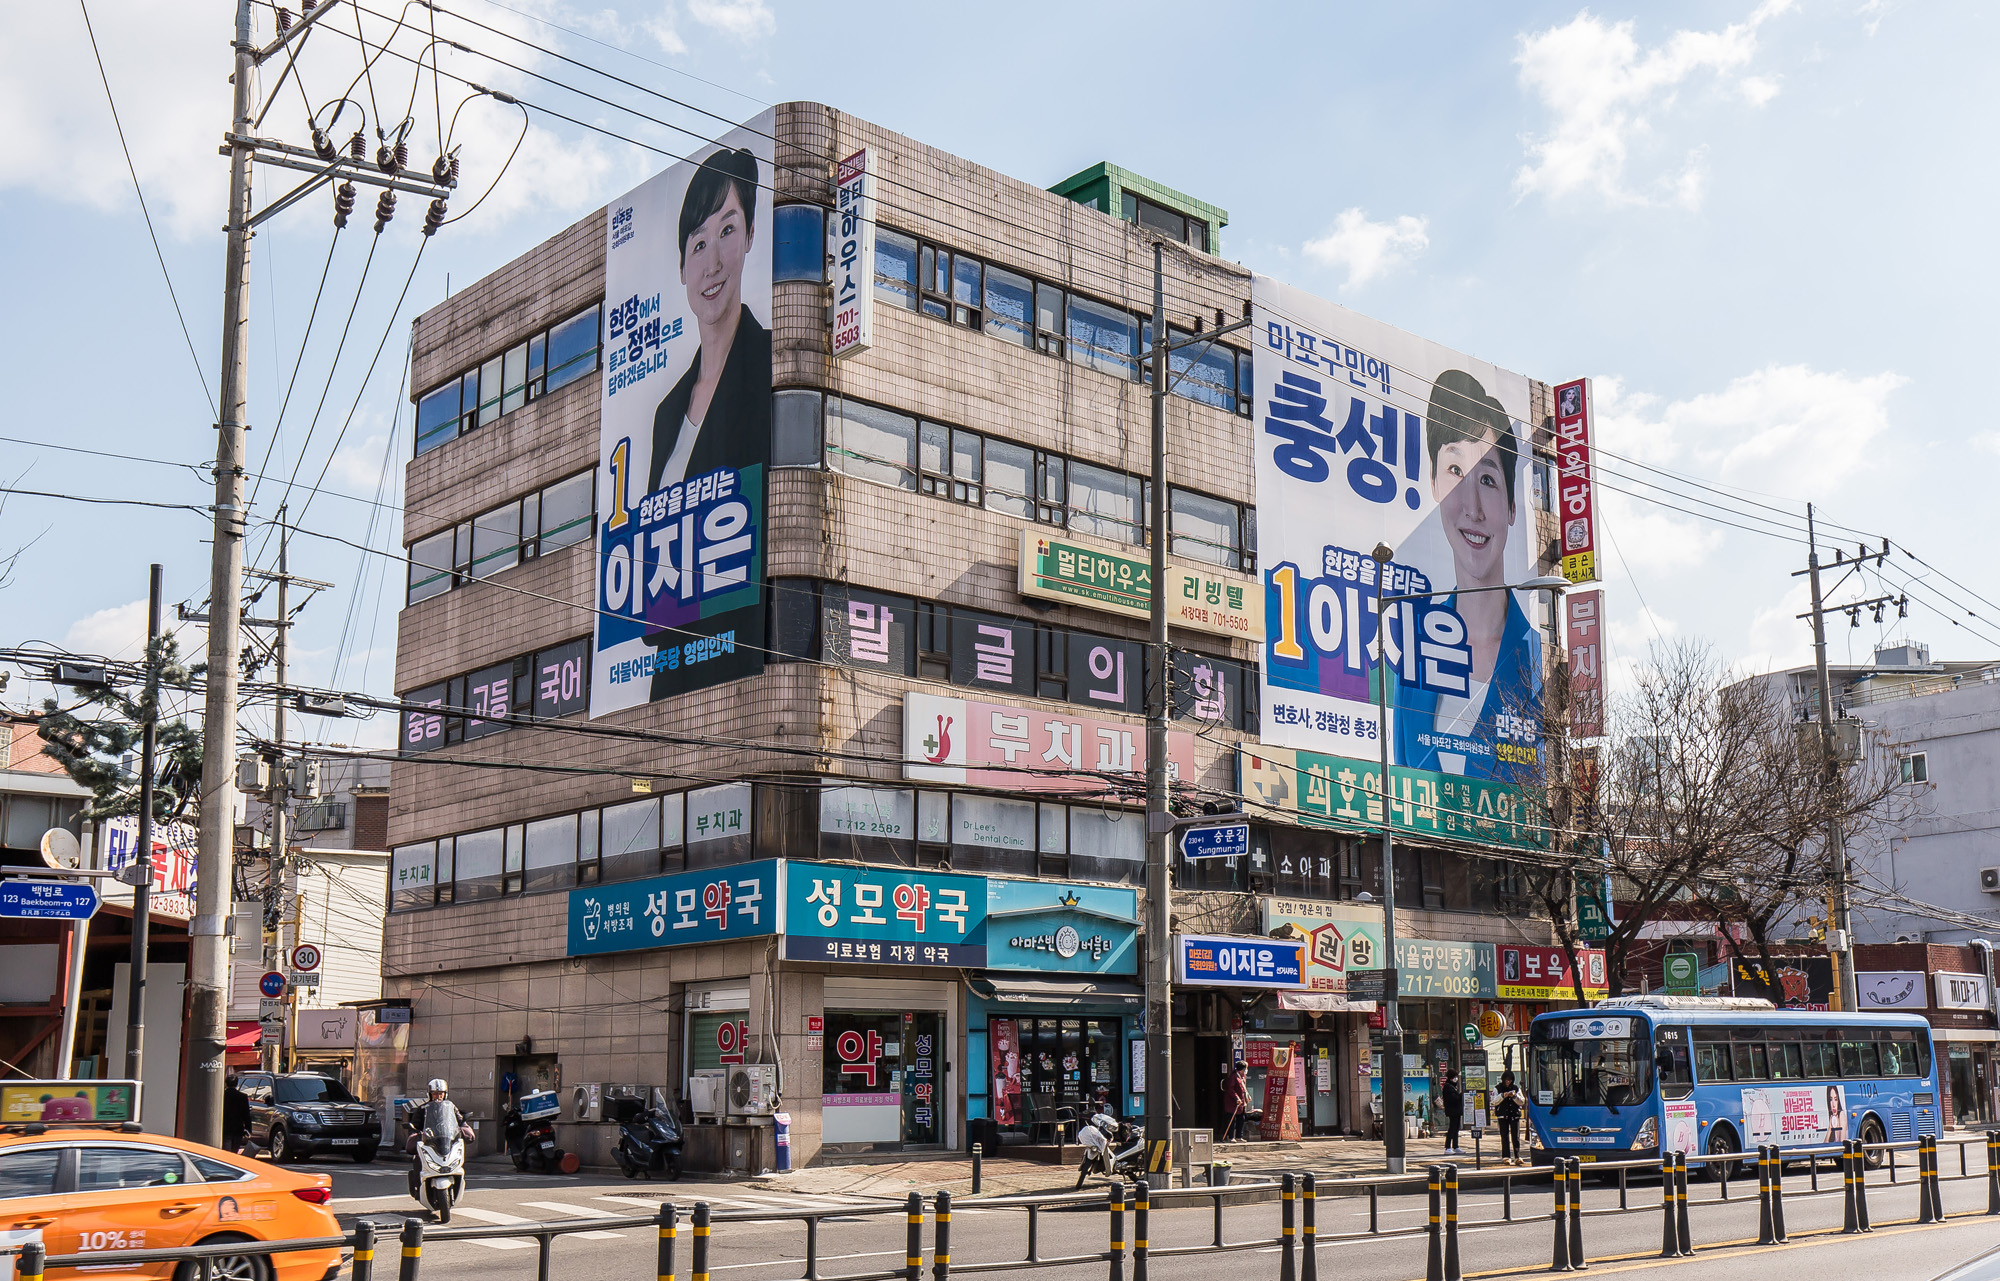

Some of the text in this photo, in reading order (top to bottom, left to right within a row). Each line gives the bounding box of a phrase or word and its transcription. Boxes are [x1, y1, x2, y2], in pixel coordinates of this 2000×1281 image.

[838, 153, 865, 181] 리빙텔
[612, 206, 634, 231] 민주당
[609, 292, 660, 341] 현장에서
[836, 307, 860, 330] 701-
[627, 316, 684, 363] 정책으로
[834, 325, 860, 350] 5503
[609, 346, 627, 373] 듣고
[1267, 320, 1391, 396] 마포구민에
[608, 348, 668, 398] 답하겠습니다
[1264, 369, 1421, 511] 충성!
[1560, 418, 1590, 515] 보옥당
[608, 440, 630, 533] 1
[640, 470, 735, 528] 현장을 달리는
[605, 500, 753, 616] 이지은
[1324, 549, 1426, 598] 현장을 달리는
[1182, 575, 1244, 611] 리빙텔
[1180, 605, 1249, 632] 서강대점 701-5503
[1272, 564, 1304, 661] 1
[1308, 582, 1469, 693] 이지은
[609, 629, 735, 685] 더불어민주당 영입인재
[1571, 599, 1599, 726] 부치과
[408, 656, 582, 744] 중등 고등 국어
[1273, 703, 1314, 730] 변호사,
[1315, 709, 1351, 736] 경찰청
[988, 710, 1136, 773] 부치과
[1416, 732, 1491, 757] 서울 마포갑 국회의원후보
[1306, 763, 1439, 830] 최호열내과
[696, 808, 743, 836] 부치과
[963, 820, 996, 833] Dr.Lee's
[974, 833, 1025, 847] Dental Clinic
[1197, 843, 1245, 856] Sungmun-gil
[1213, 828, 1246, 844] 숭문길
[399, 864, 431, 887] 부치과
[1280, 855, 1332, 880] 소아과
[3, 894, 91, 907] 123 Baekbeom-ro 127
[31, 885, 64, 898] 백범로
[607, 900, 631, 916] 병의원
[643, 877, 763, 938] 성모약국
[805, 877, 970, 936] 성모약국
[1277, 901, 1333, 917] 당첨! 행운의 집
[602, 917, 634, 933] 처방조제
[298, 951, 315, 964] 30
[825, 942, 949, 963] 의료보험 지정 약국
[1009, 933, 1056, 952] 아마스빈
[1079, 934, 1113, 961] 버블티
[1394, 944, 1491, 973] 서울공인중개사
[1218, 947, 1275, 977] 이지은
[1295, 946, 1305, 985] 1
[291, 974, 318, 984] 여기부터
[1405, 974, 1480, 995] 717-0039
[1480, 1016, 1500, 1032] 부동산
[1663, 1031, 1679, 1040] 1615
[716, 1018, 750, 1066] 약
[1435, 1048, 1449, 1061] 서울
[836, 1029, 883, 1087] 약
[914, 1034, 933, 1128] 성모약국
[1040, 1085, 1056, 1093] TEA
[1269, 1086, 1284, 1095] 2번
[1271, 1077, 1285, 1086] 1등
[1859, 1083, 1879, 1099] 110A
[1783, 1097, 1814, 1114] 바닐라코
[1781, 1114, 1819, 1131] 화이트쿠션
[77, 1231, 128, 1251] 10%
